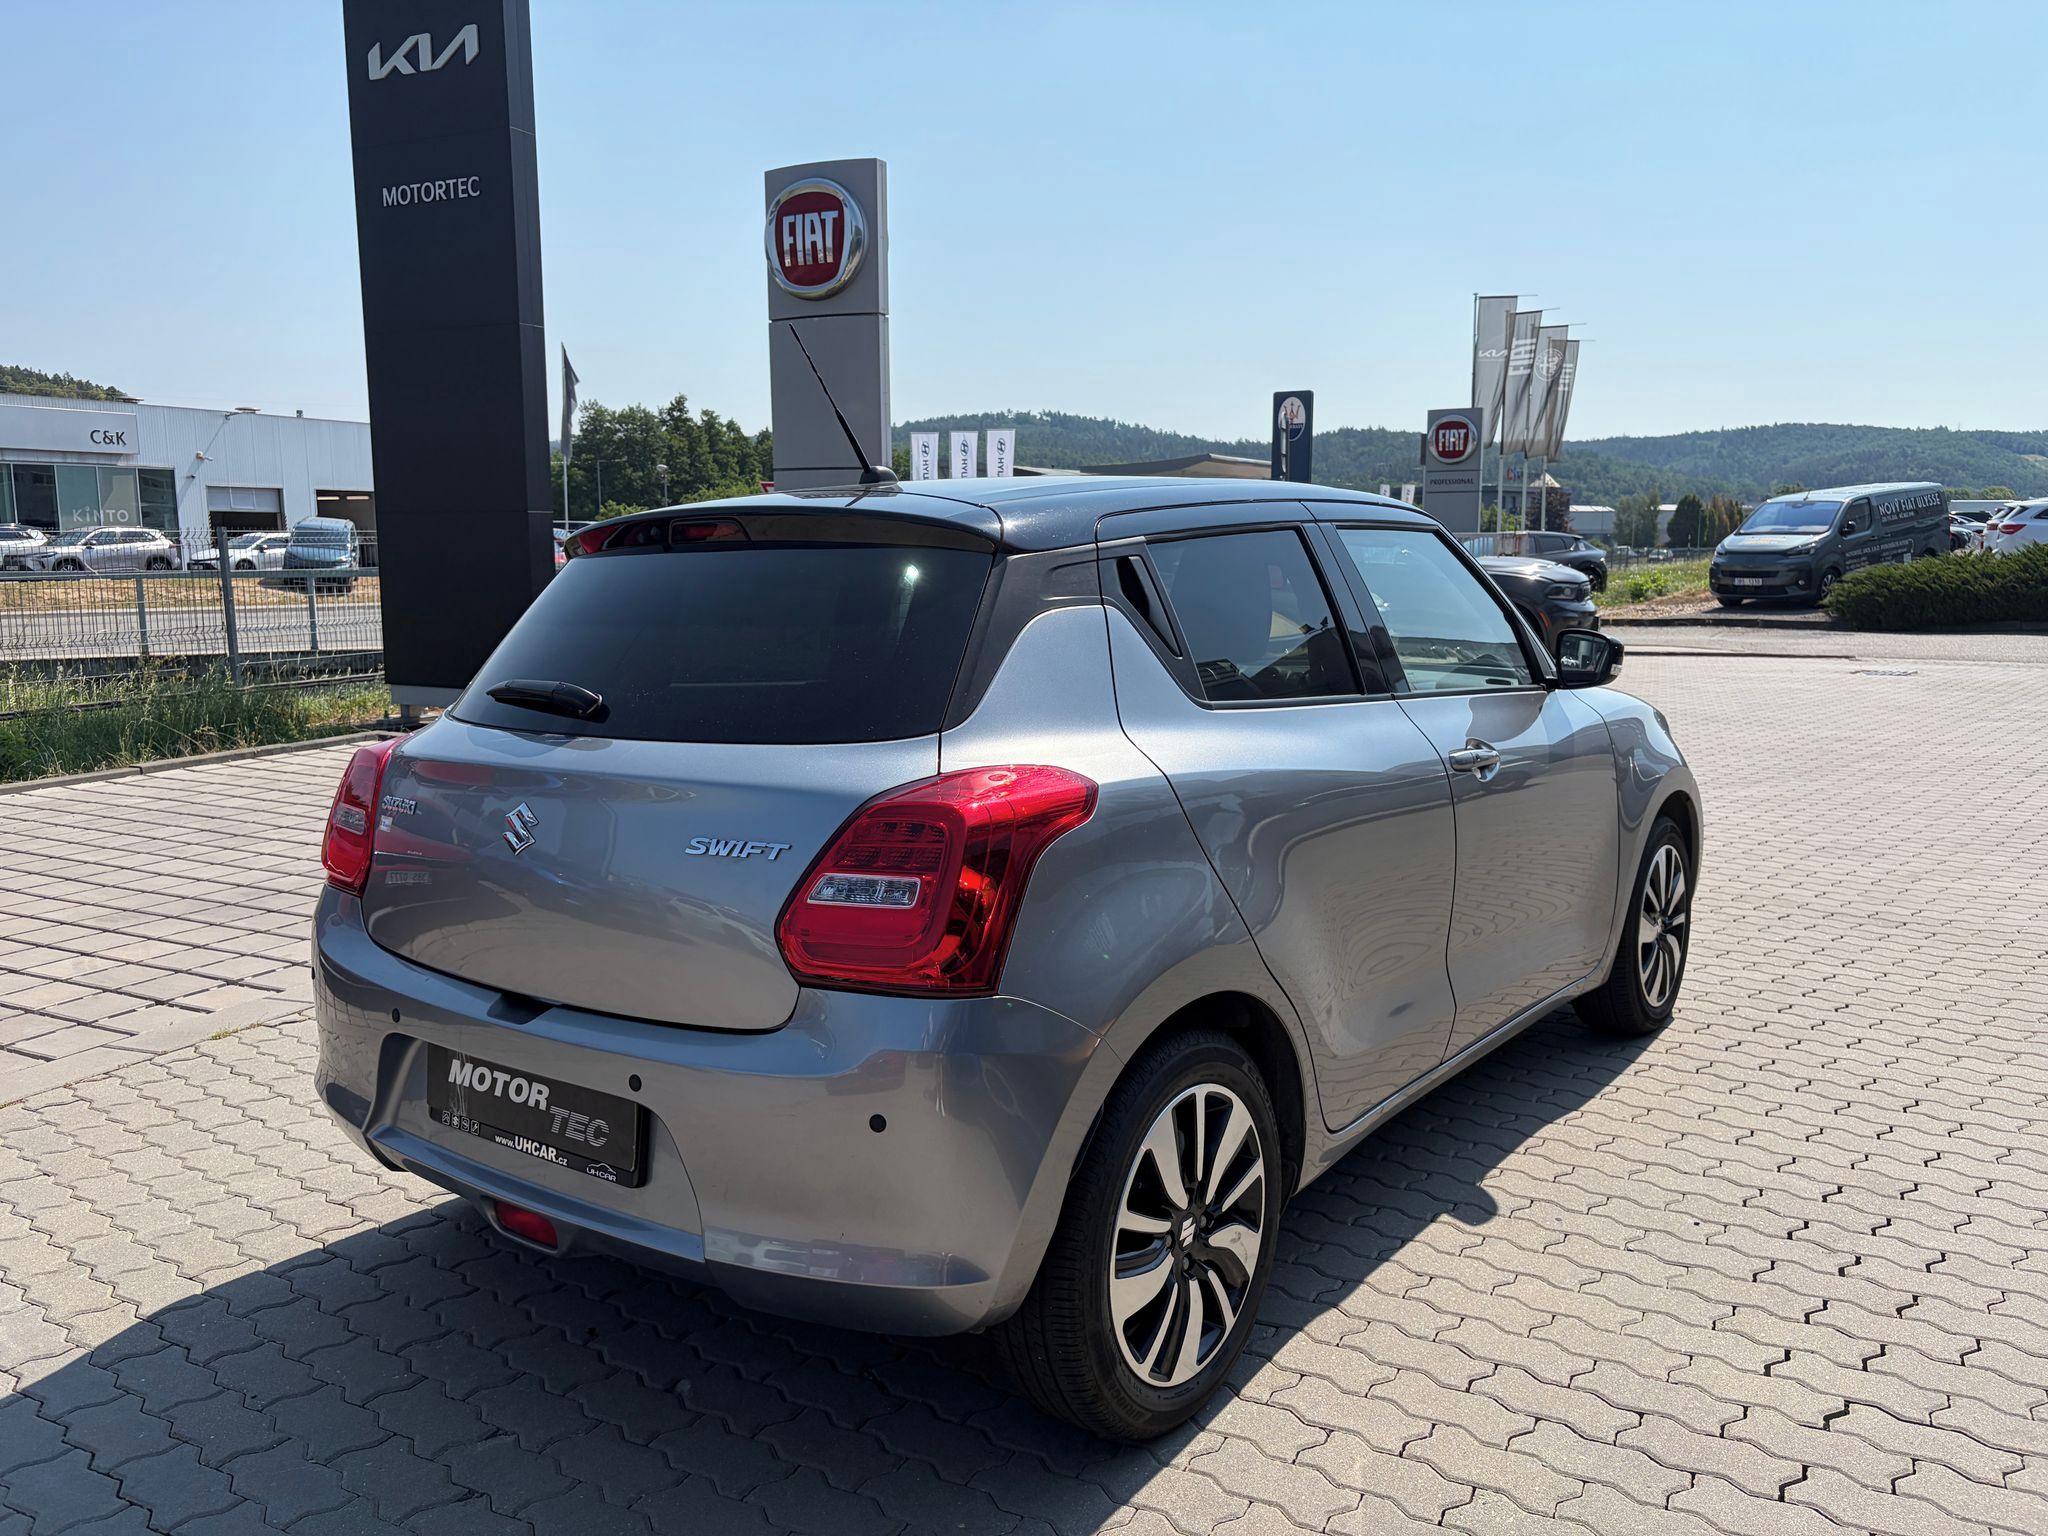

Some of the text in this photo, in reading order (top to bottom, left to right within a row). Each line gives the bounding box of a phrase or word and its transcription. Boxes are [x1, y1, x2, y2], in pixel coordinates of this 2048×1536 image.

[368, 24, 479, 80] KIA
[382, 176, 481, 207] MOTORTEC
[782, 210, 838, 267] FIAT
[90, 429, 127, 446] C&K
[1438, 428, 1467, 452] FIAT
[1901, 497, 1916, 511] FIAT
[1916, 493, 1941, 508] ULYSSE
[684, 837, 792, 861] SWIFT
[447, 1059, 610, 1147] MOTOR TEC
[494, 1134, 568, 1166] www.UHCAR.cz
